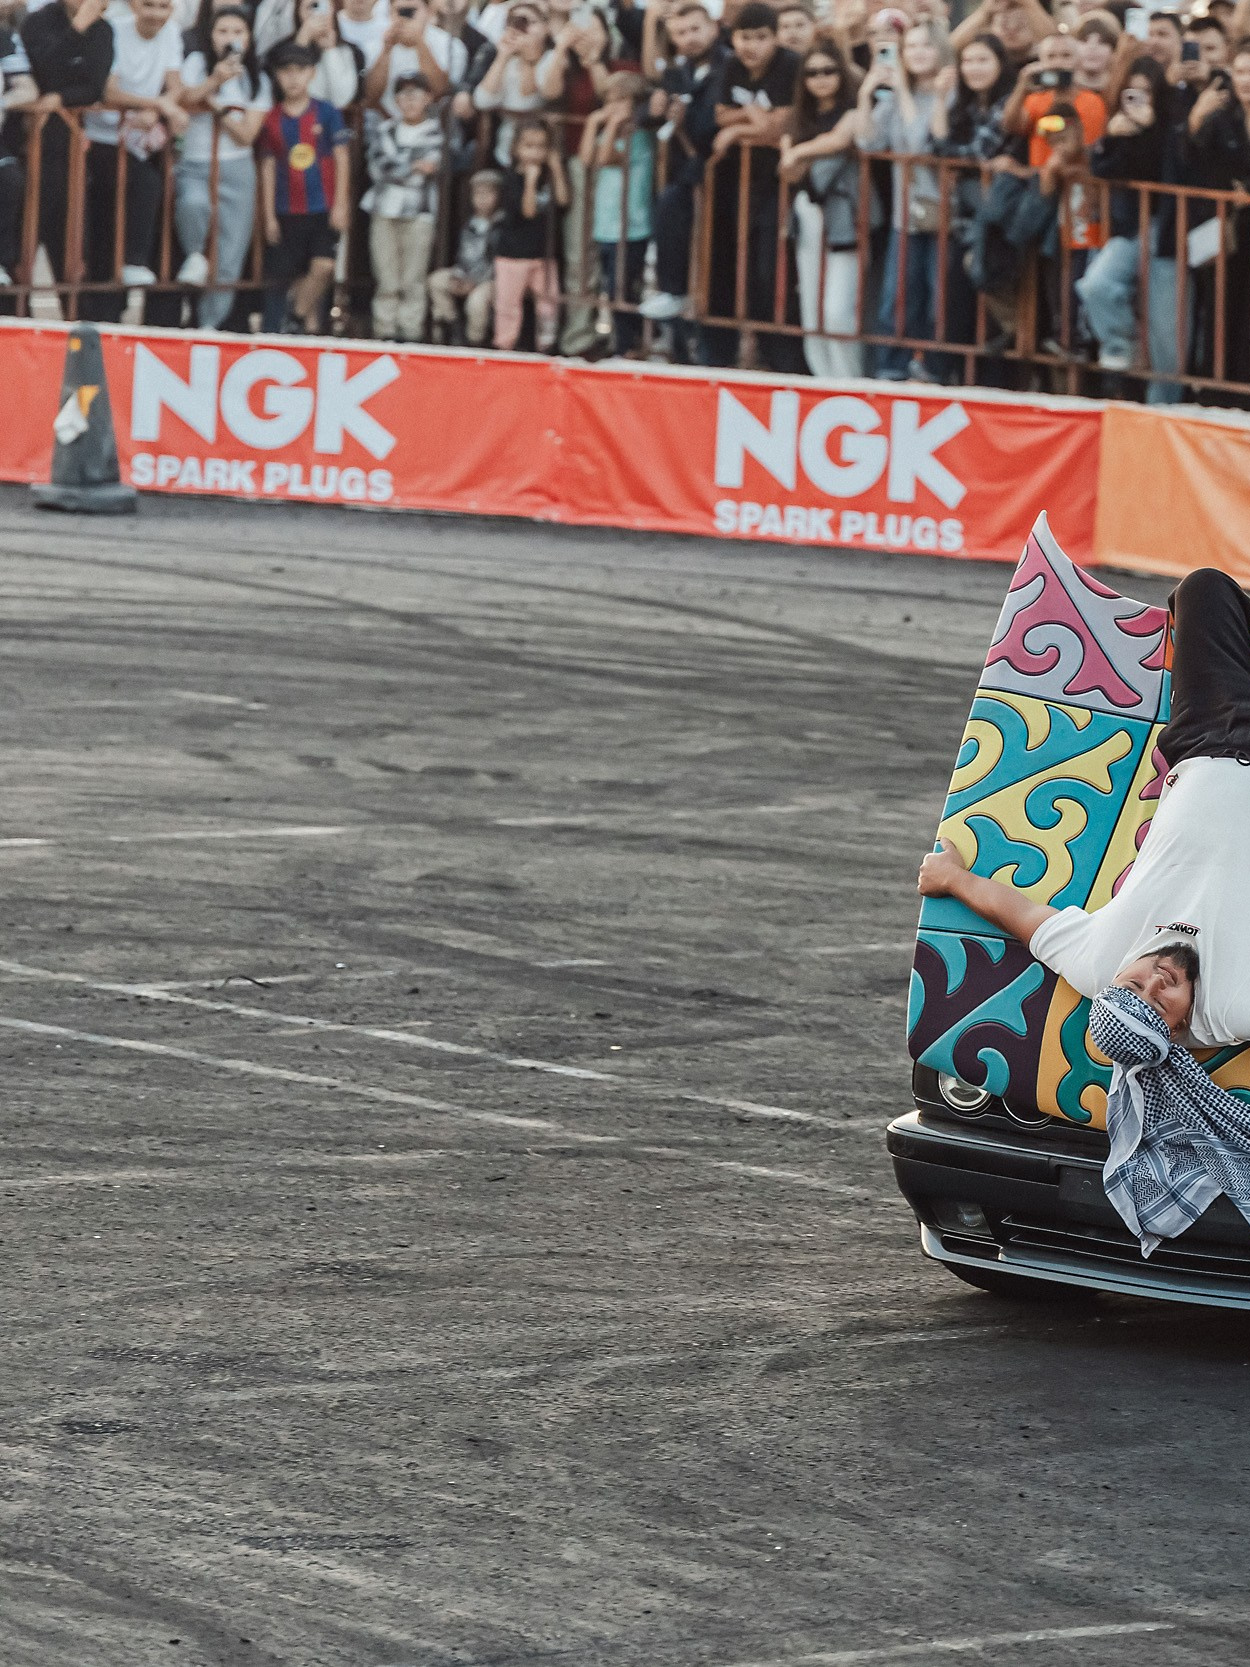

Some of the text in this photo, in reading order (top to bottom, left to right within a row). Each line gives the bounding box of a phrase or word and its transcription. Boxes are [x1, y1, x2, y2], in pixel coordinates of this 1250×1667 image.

[131, 341, 400, 461] NGK
[130, 453, 394, 502] SPARK PLUGS
[714, 387, 972, 511] NGK
[713, 499, 964, 550] SPARK PLUGS
